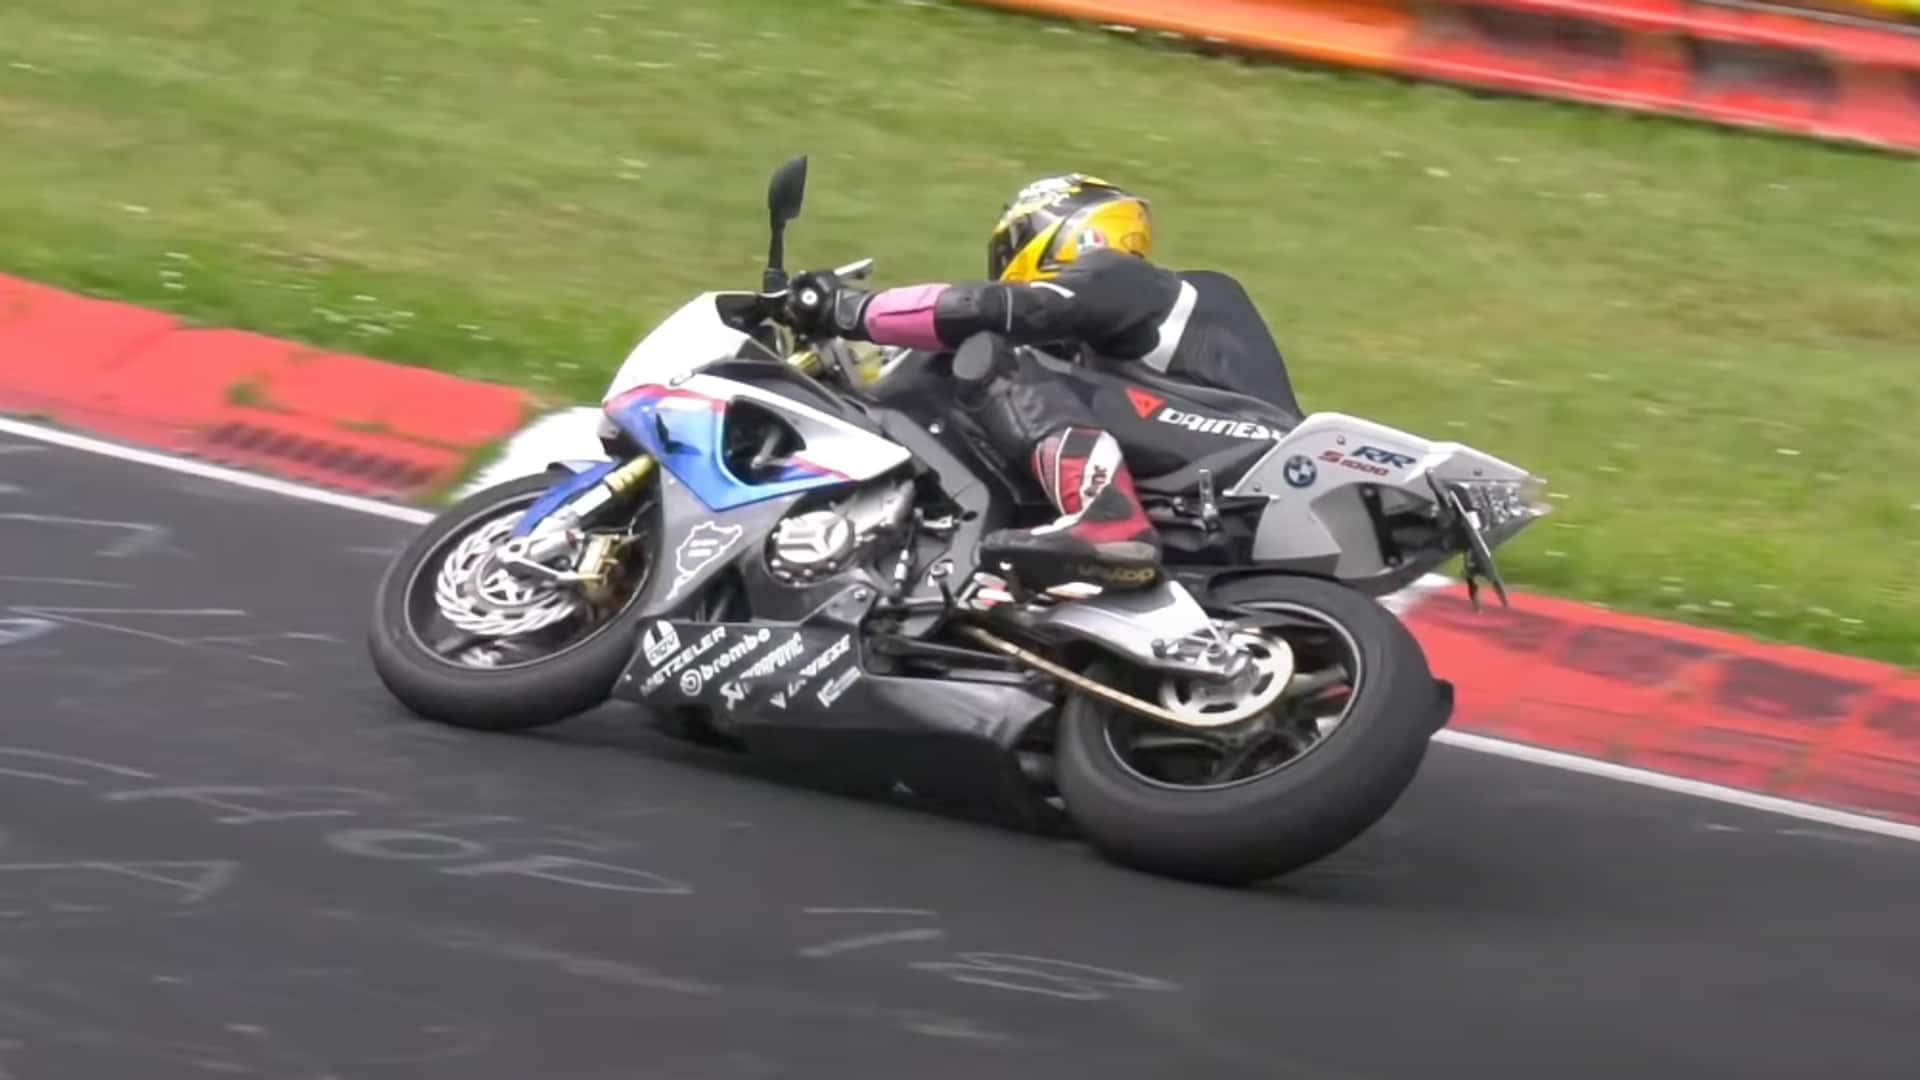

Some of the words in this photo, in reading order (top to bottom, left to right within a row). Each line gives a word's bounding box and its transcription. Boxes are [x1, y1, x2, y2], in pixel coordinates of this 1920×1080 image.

[1157, 407, 1283, 441] DAINES
[1318, 449, 1345, 464] S
[1340, 458, 1390, 477] 1000
[1350, 445, 1418, 469] RR
[640, 626, 726, 696] METZELER
[699, 628, 771, 681] brembo
